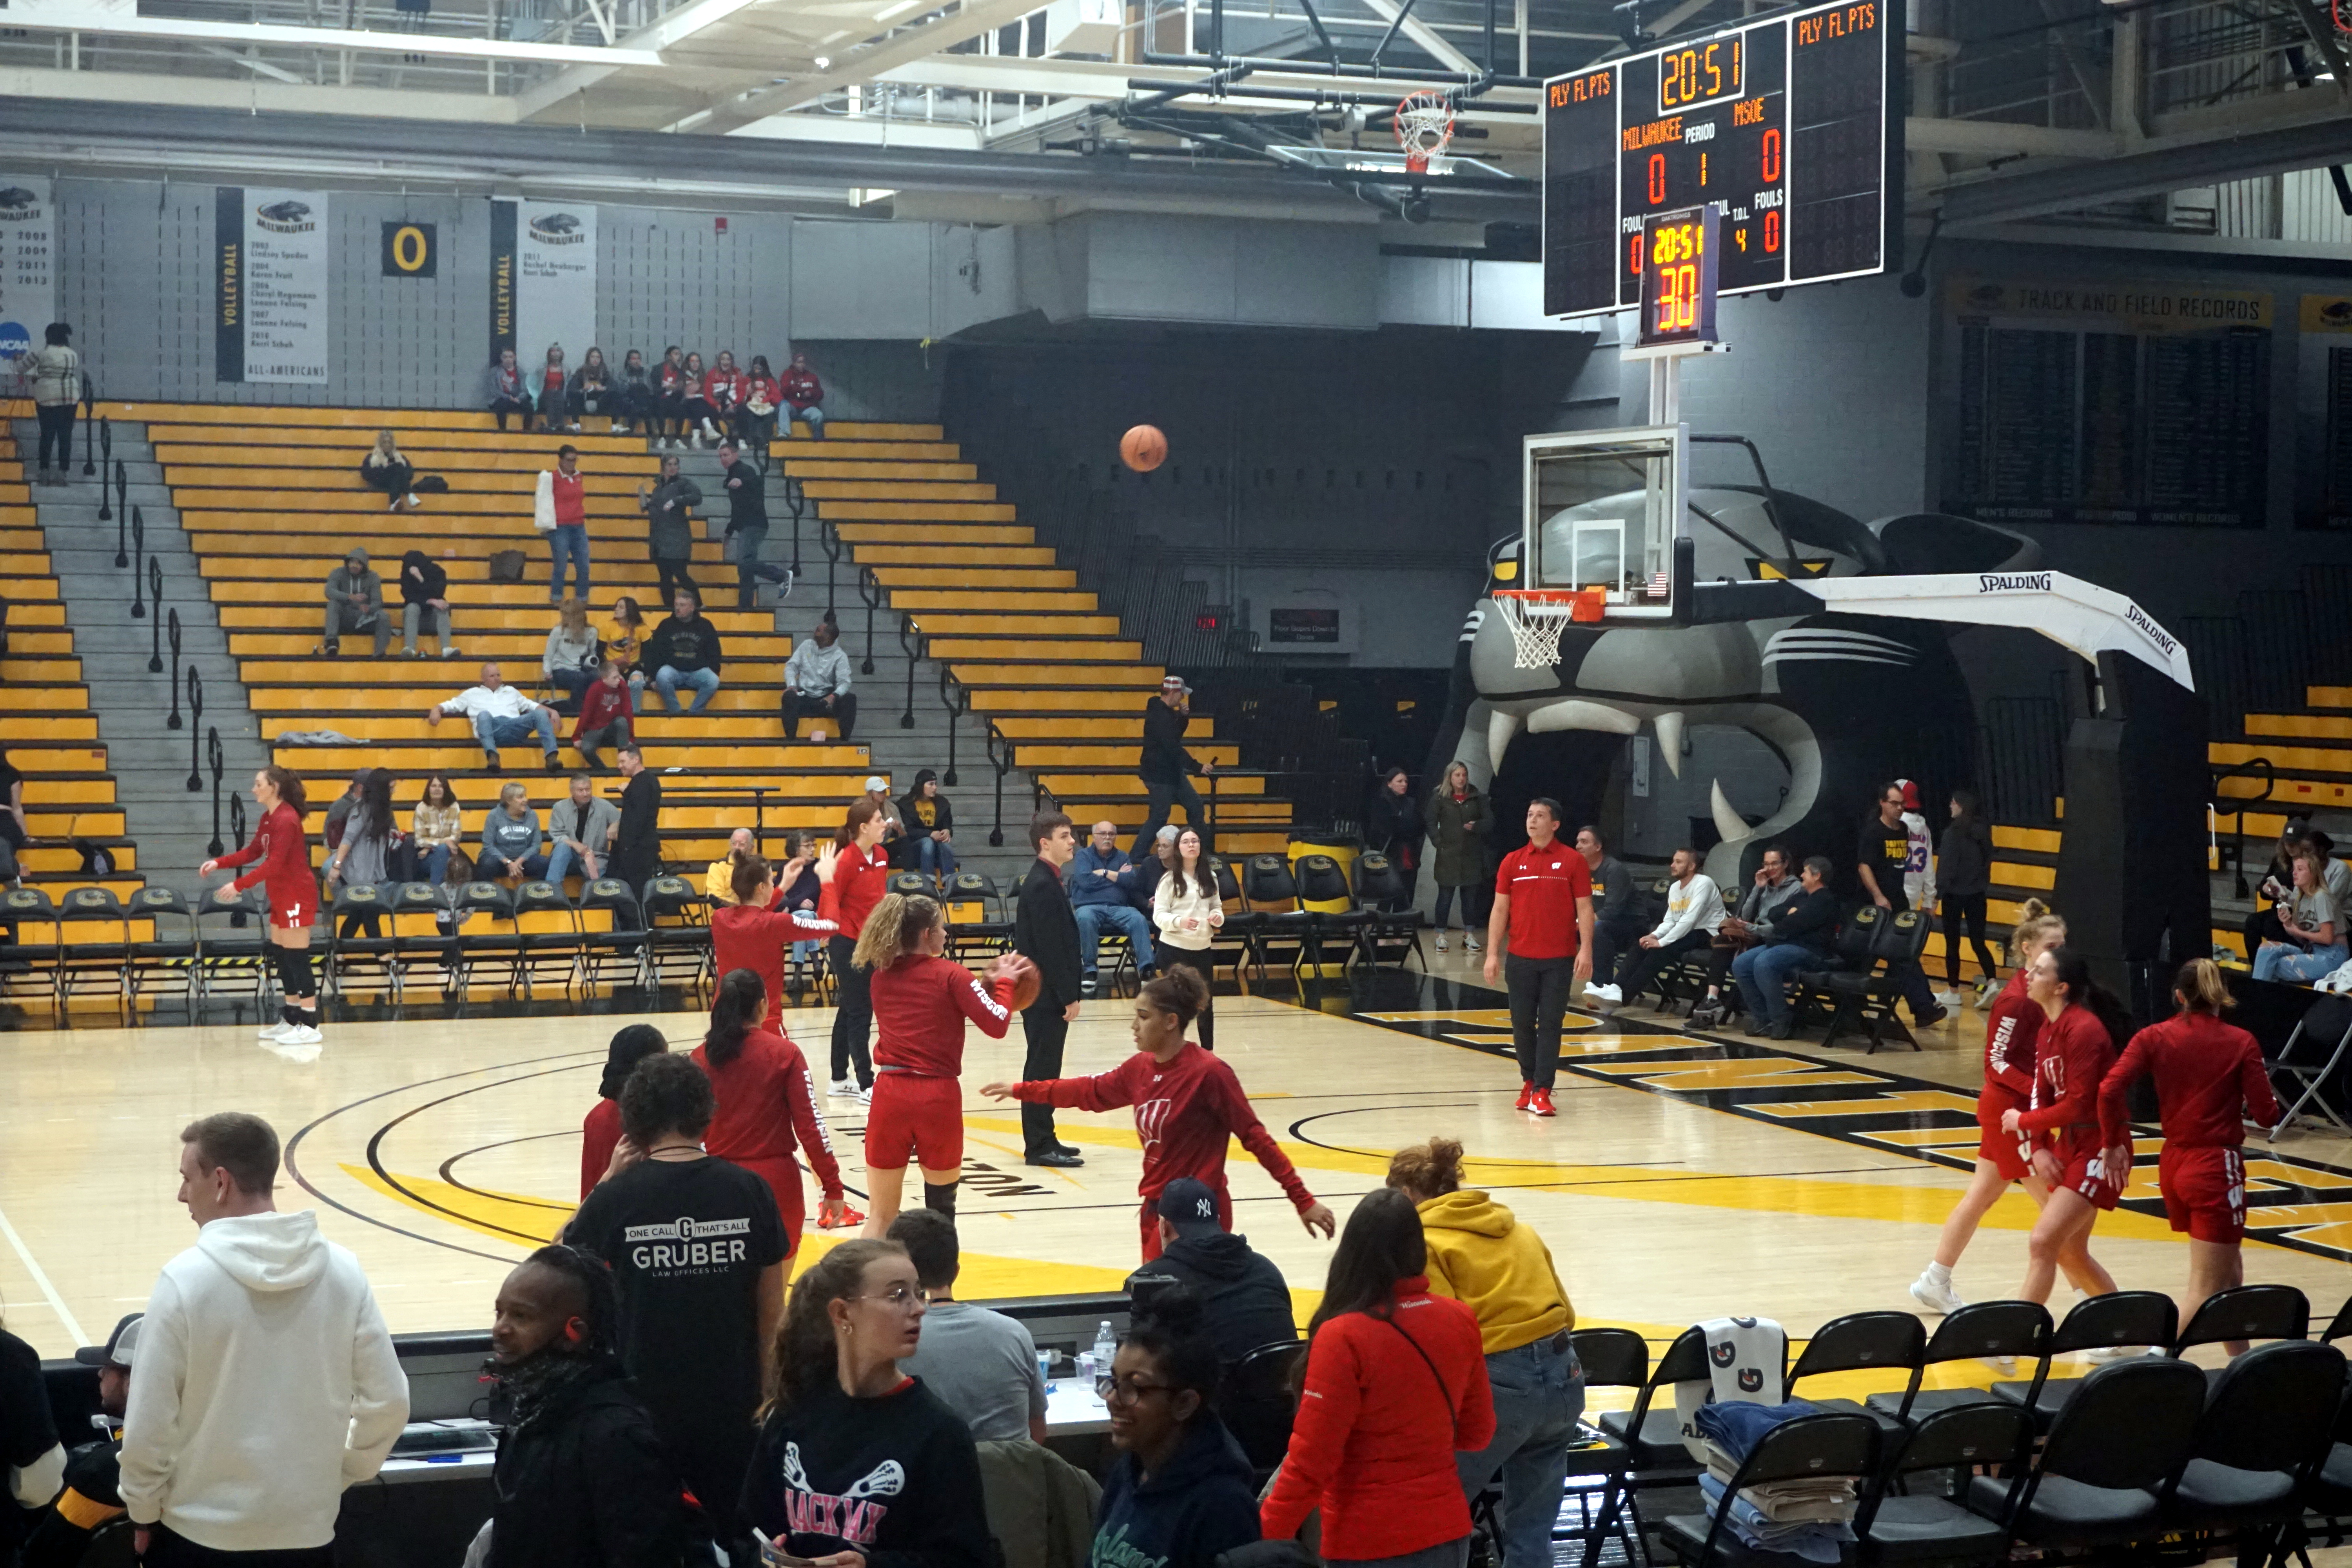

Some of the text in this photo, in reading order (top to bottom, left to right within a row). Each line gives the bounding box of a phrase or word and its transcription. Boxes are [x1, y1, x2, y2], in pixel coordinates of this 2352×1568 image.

[1799, 17, 1823, 45] PLY
[1848, 4, 1875, 31] PTS
[1663, 42, 1739, 105] 20:51
[1551, 83, 1570, 108] PLY
[1589, 72, 1611, 98] PTS
[1734, 97, 1765, 127] MSOE
[1623, 116, 1683, 151] MILWAUKEE
[1685, 122, 1715, 144] PERIOD
[1701, 152, 1707, 187] 1
[1762, 129, 1781, 183] 0
[1649, 153, 1666, 205] 0
[1755, 189, 1783, 210] FOULS
[257, 217, 315, 233] MILWAUKEE
[530, 230, 584, 245] MILWAUKEE
[1622, 214, 1644, 234] FOUL
[1764, 211, 1780, 253] 0
[1653, 224, 1703, 265] 20:51
[1735, 229, 1747, 253] 4
[224, 244, 237, 326] VOLLEYBALL
[497, 255, 509, 335] VOLLEYBALL
[1659, 264, 1696, 330] 30
[2018, 289, 2076, 311] TRACK
[2082, 292, 2117, 313] AND
[2125, 295, 2172, 317] FIELD
[2179, 299, 2259, 321] RECORDS
[1980, 573, 2051, 593] SPALDING
[2124, 604, 2177, 655] SPALDING
[1197, 1198, 1212, 1218] NY
[629, 1227, 674, 1238] ONE CALL
[679, 1219, 693, 1238] G
[696, 1222, 747, 1234] THAT'S ALL
[632, 1239, 746, 1269] GRUBER
[674, 1268, 710, 1276] OFFICES
